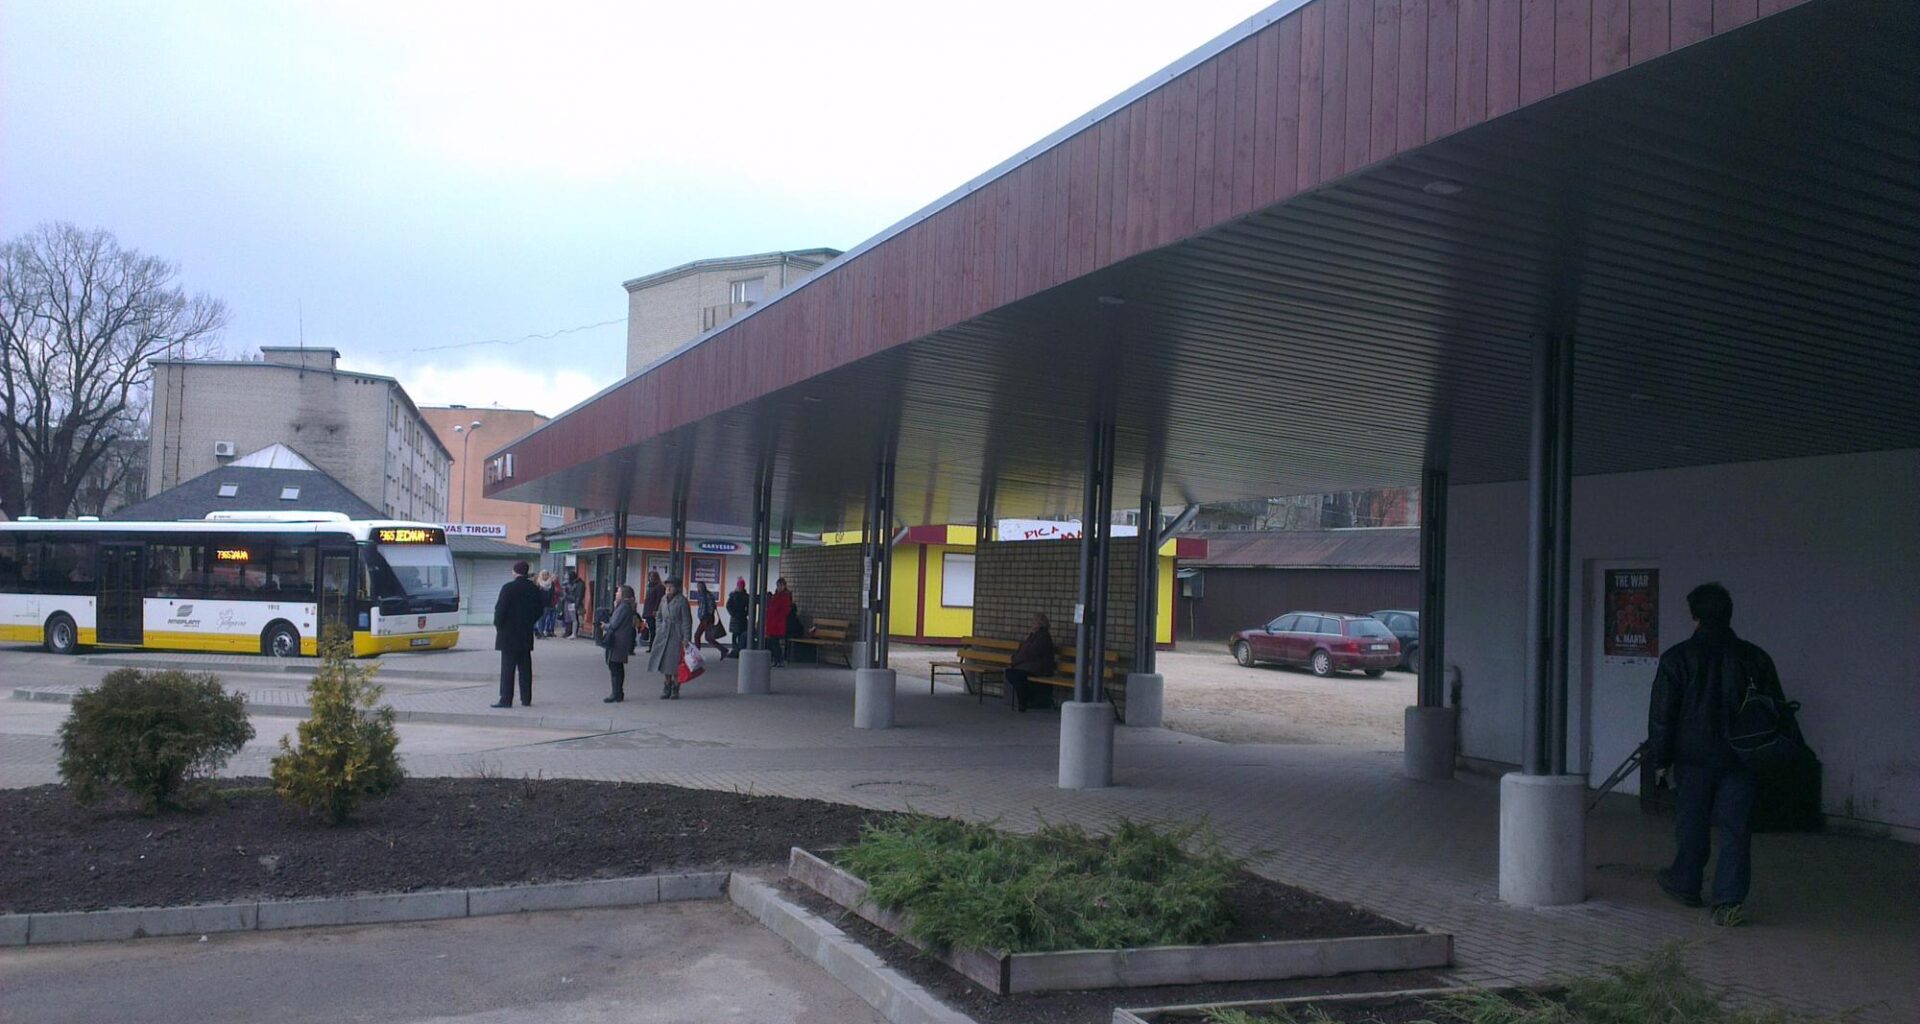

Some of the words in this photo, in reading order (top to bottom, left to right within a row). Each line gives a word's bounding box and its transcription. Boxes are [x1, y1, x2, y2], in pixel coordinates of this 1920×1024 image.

[465, 526, 501, 534] TIRGUS
[1615, 575, 1629, 588] THE
[1630, 575, 1649, 588] WAR
